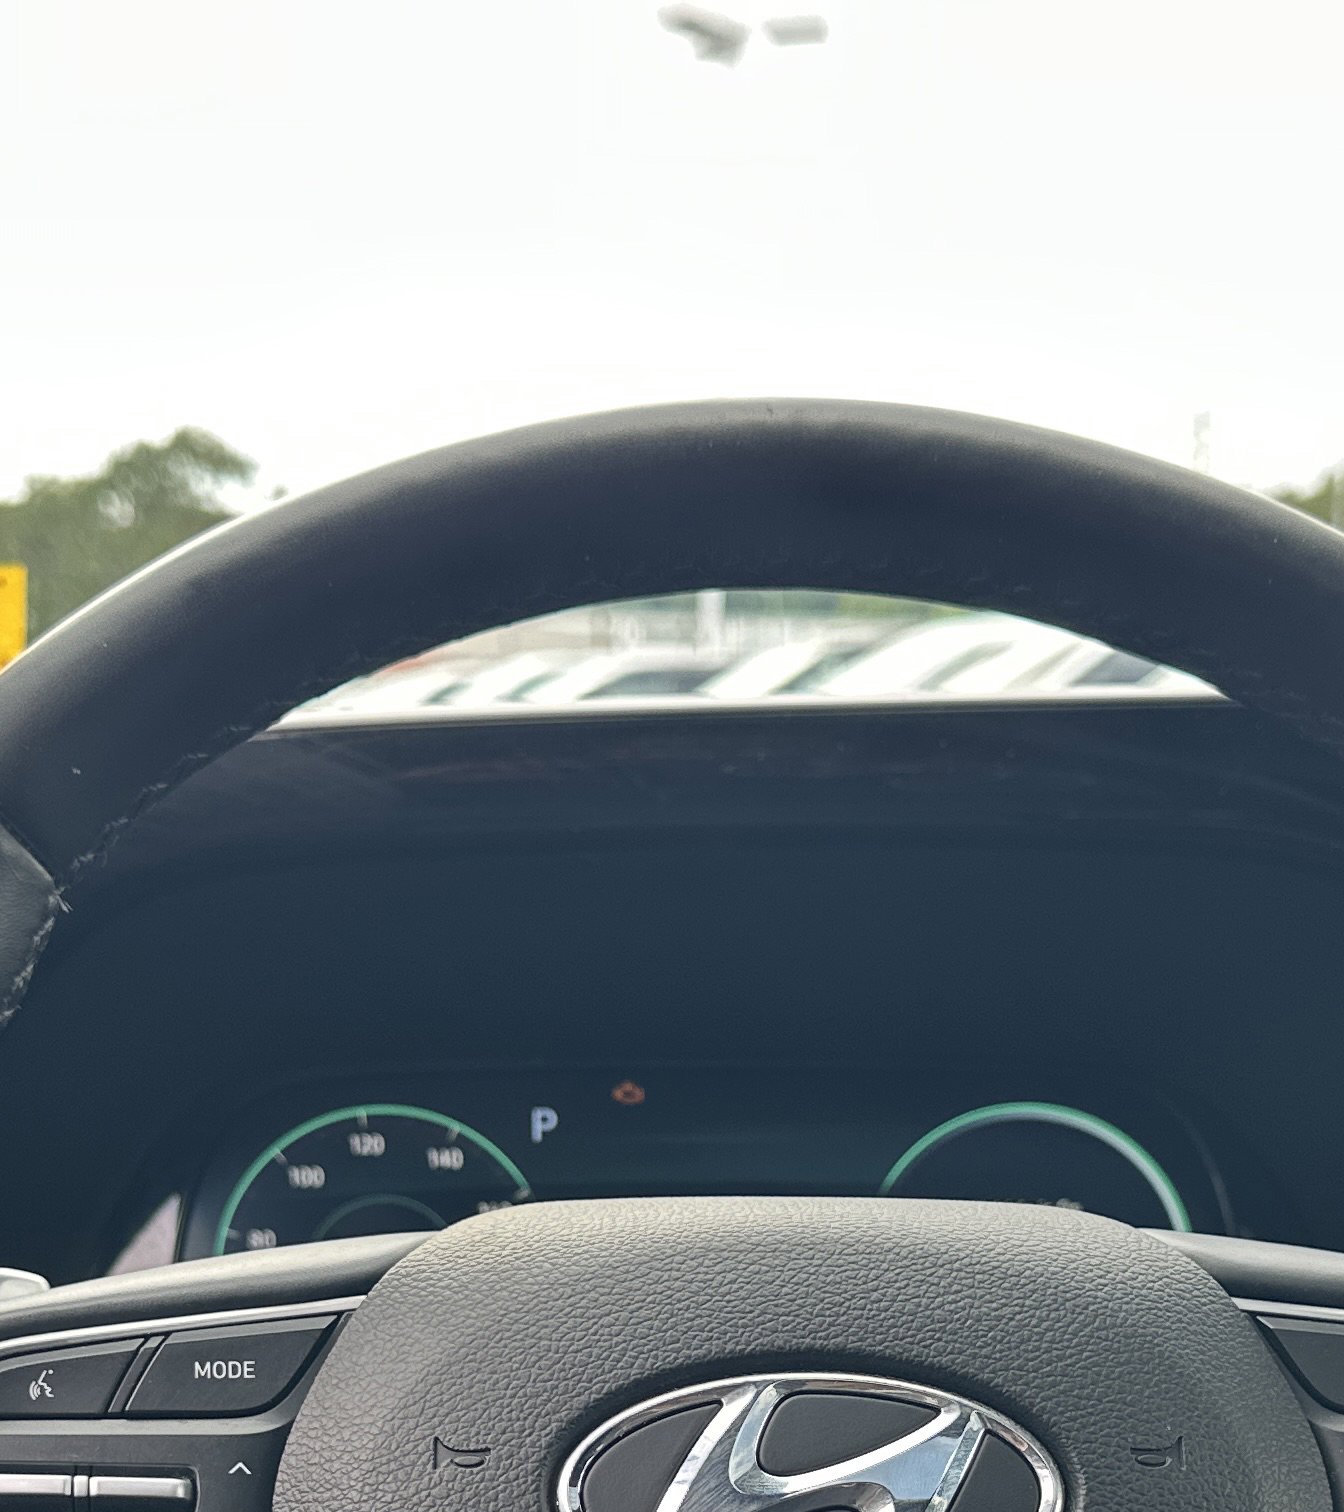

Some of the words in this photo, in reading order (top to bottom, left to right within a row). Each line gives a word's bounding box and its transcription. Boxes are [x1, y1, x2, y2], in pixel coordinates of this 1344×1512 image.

[529, 1105, 560, 1144] P
[347, 1131, 386, 1157] 120
[425, 1146, 465, 1171] 140
[287, 1163, 326, 1189] 100
[194, 1360, 257, 1380] MODE
